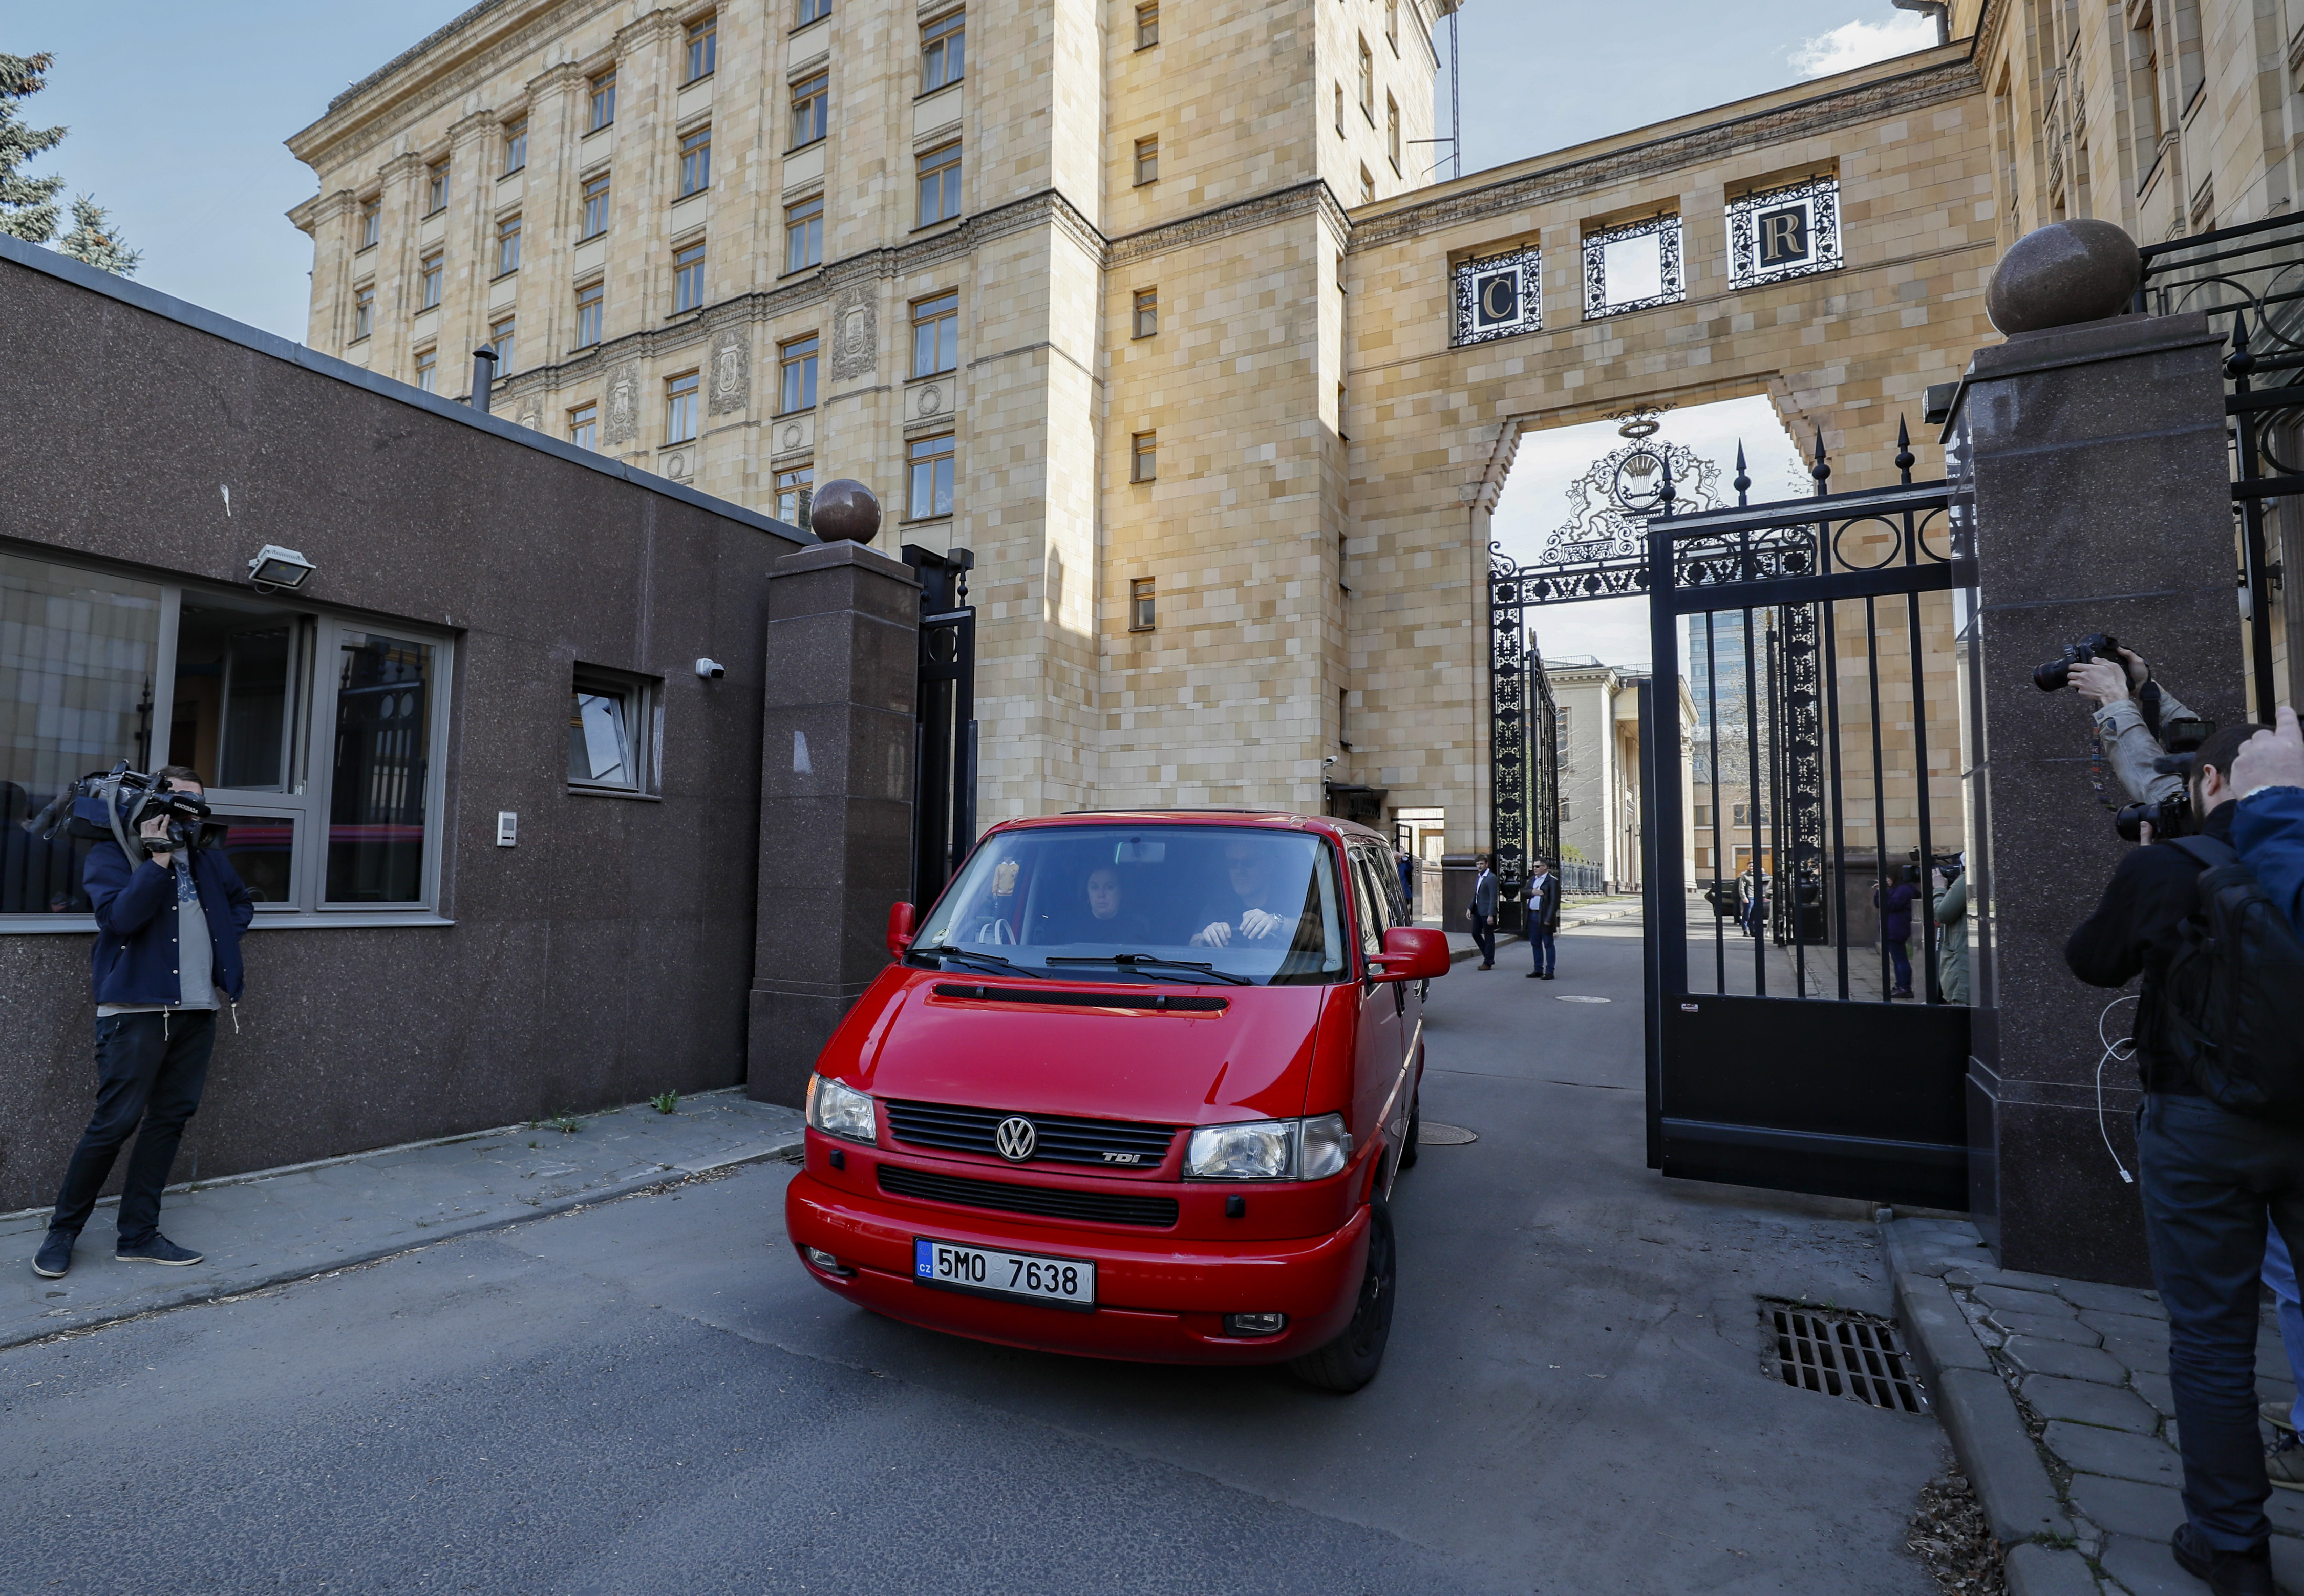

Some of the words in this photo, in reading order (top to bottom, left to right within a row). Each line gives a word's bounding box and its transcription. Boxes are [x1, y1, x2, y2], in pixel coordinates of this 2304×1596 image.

[1484, 276, 1512, 318] Č
[1762, 214, 1805, 260] R
[997, 1117, 1035, 1159] VW
[1102, 1152, 1141, 1163] TDI
[919, 1264, 931, 1273] CZ
[1009, 1259, 1077, 1295] 7638
